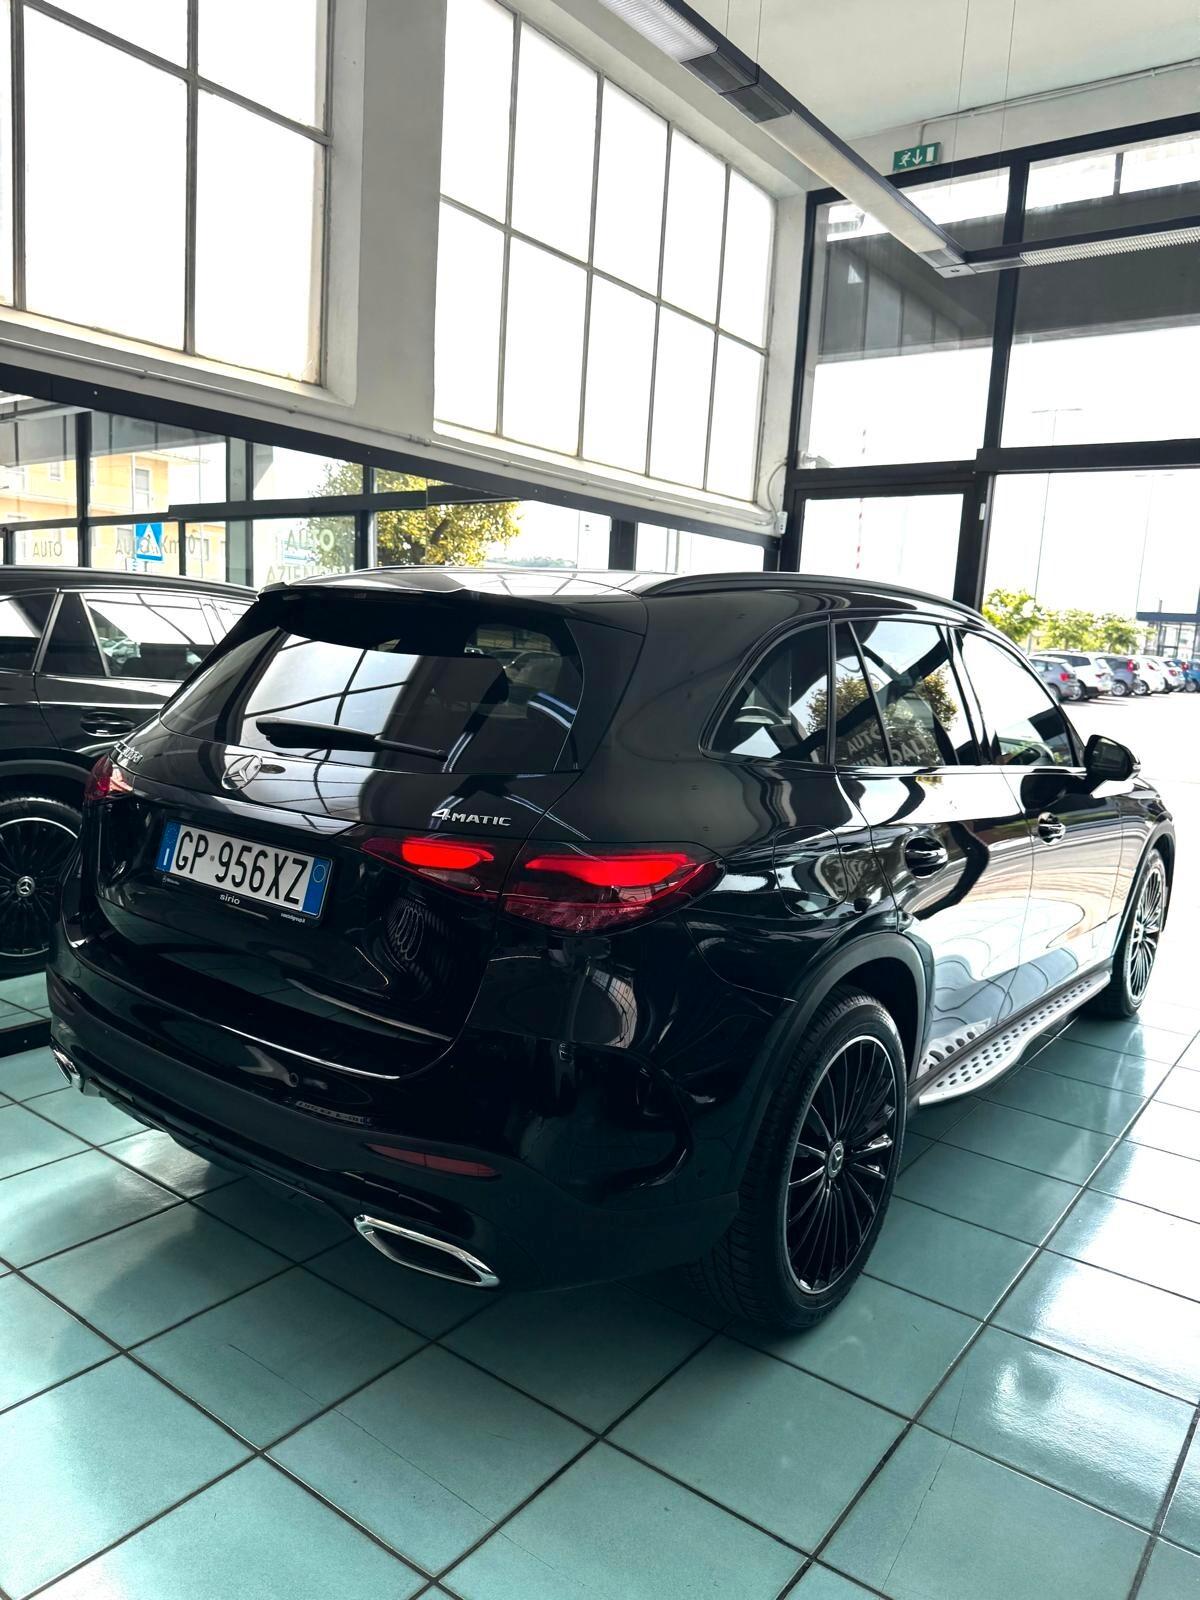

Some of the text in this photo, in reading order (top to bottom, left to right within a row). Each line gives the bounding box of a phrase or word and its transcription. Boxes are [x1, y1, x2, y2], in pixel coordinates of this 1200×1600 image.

[33, 540, 62, 557] AUTO
[287, 528, 334, 552] AUTO
[431, 808, 512, 826] 4MATIC
[219, 892, 241, 905] sirio
